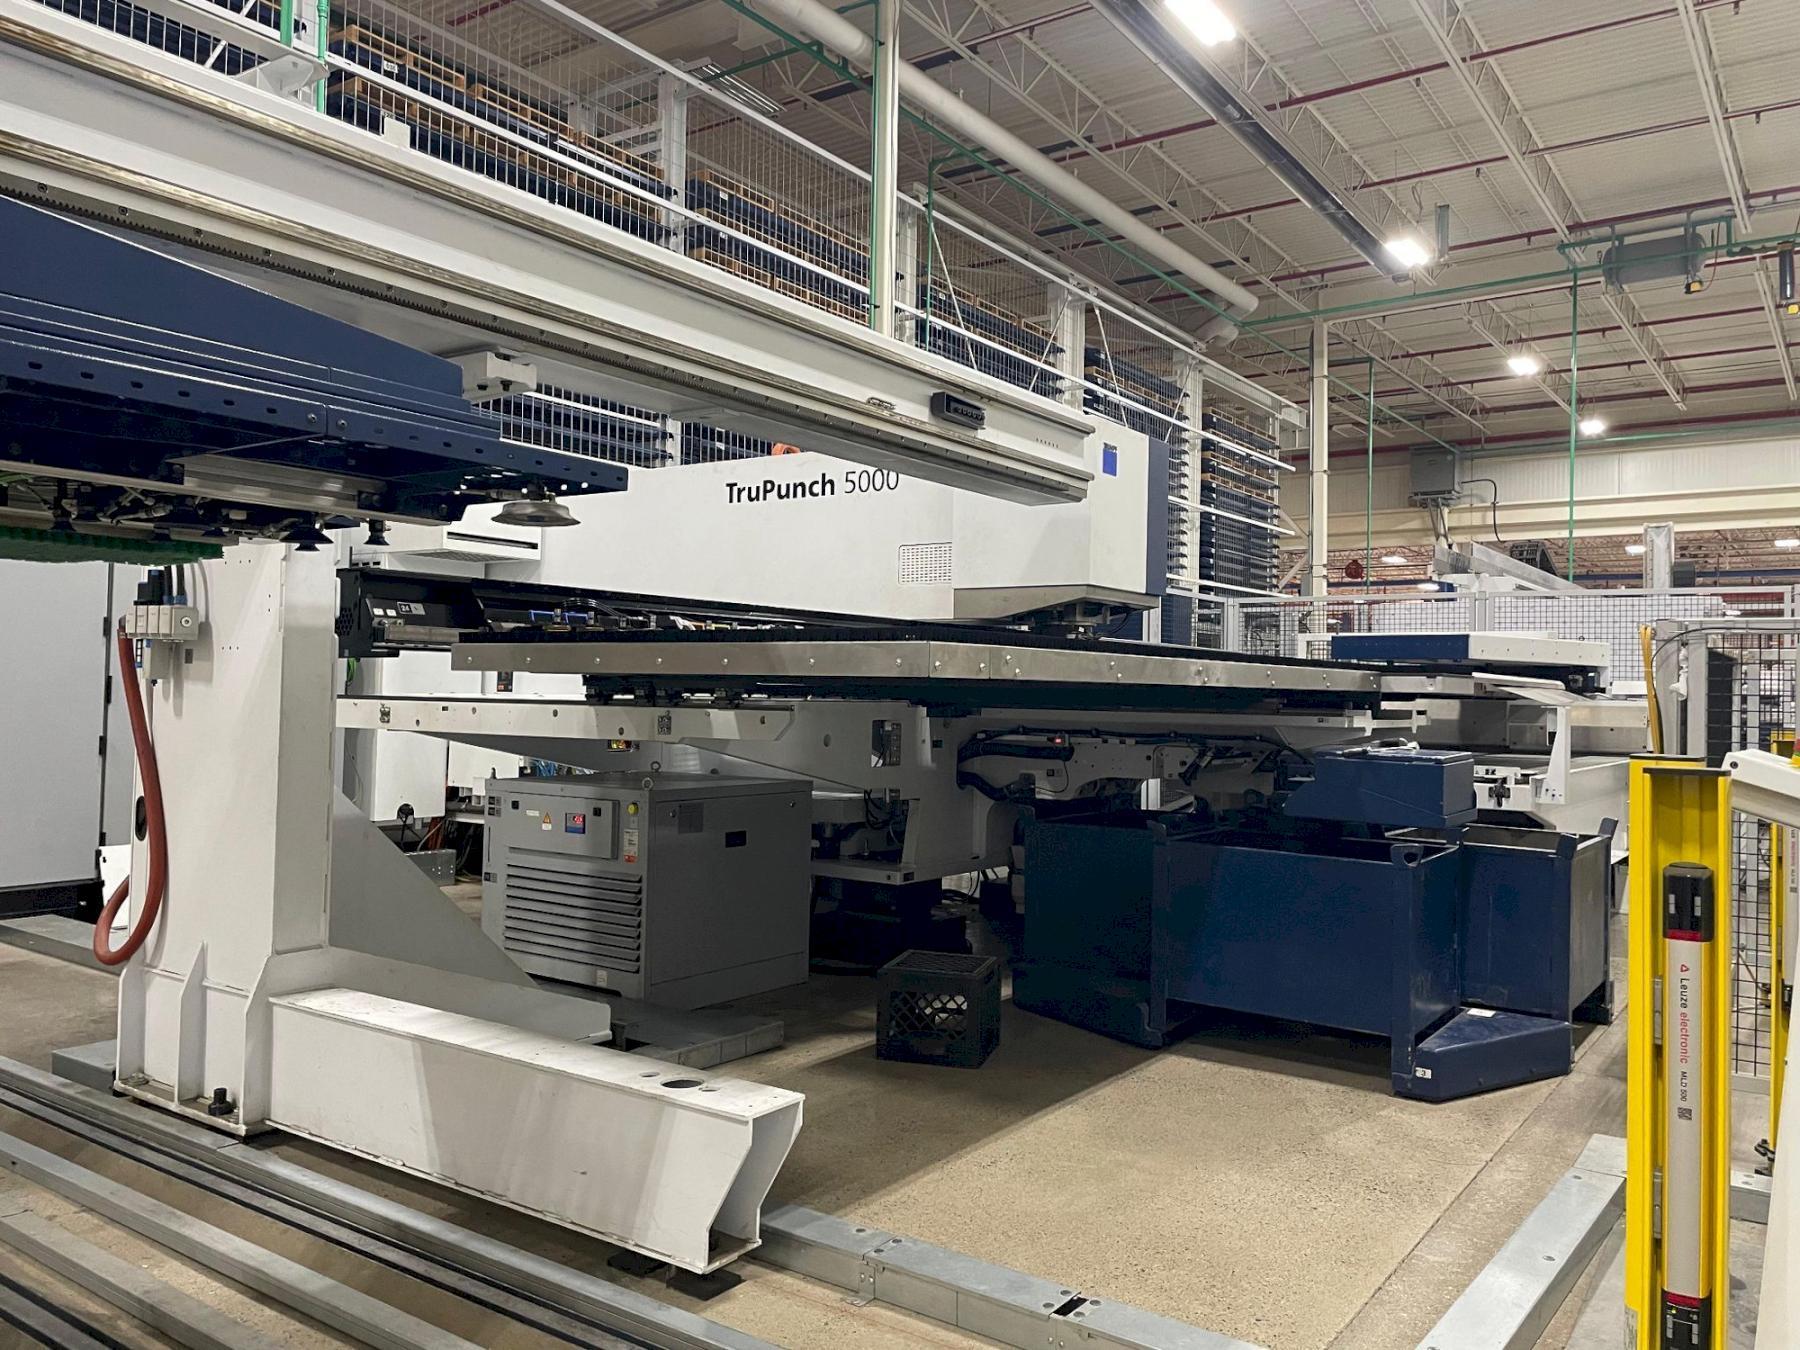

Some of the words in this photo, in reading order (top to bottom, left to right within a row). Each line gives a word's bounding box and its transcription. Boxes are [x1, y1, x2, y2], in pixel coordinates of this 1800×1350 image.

[726, 473, 835, 503] TruPunch
[844, 469, 899, 493] 5000
[1680, 978, 1690, 1008] Leuze
[1679, 1012, 1690, 1064] electronic
[1680, 1070, 1688, 1088] MLD
